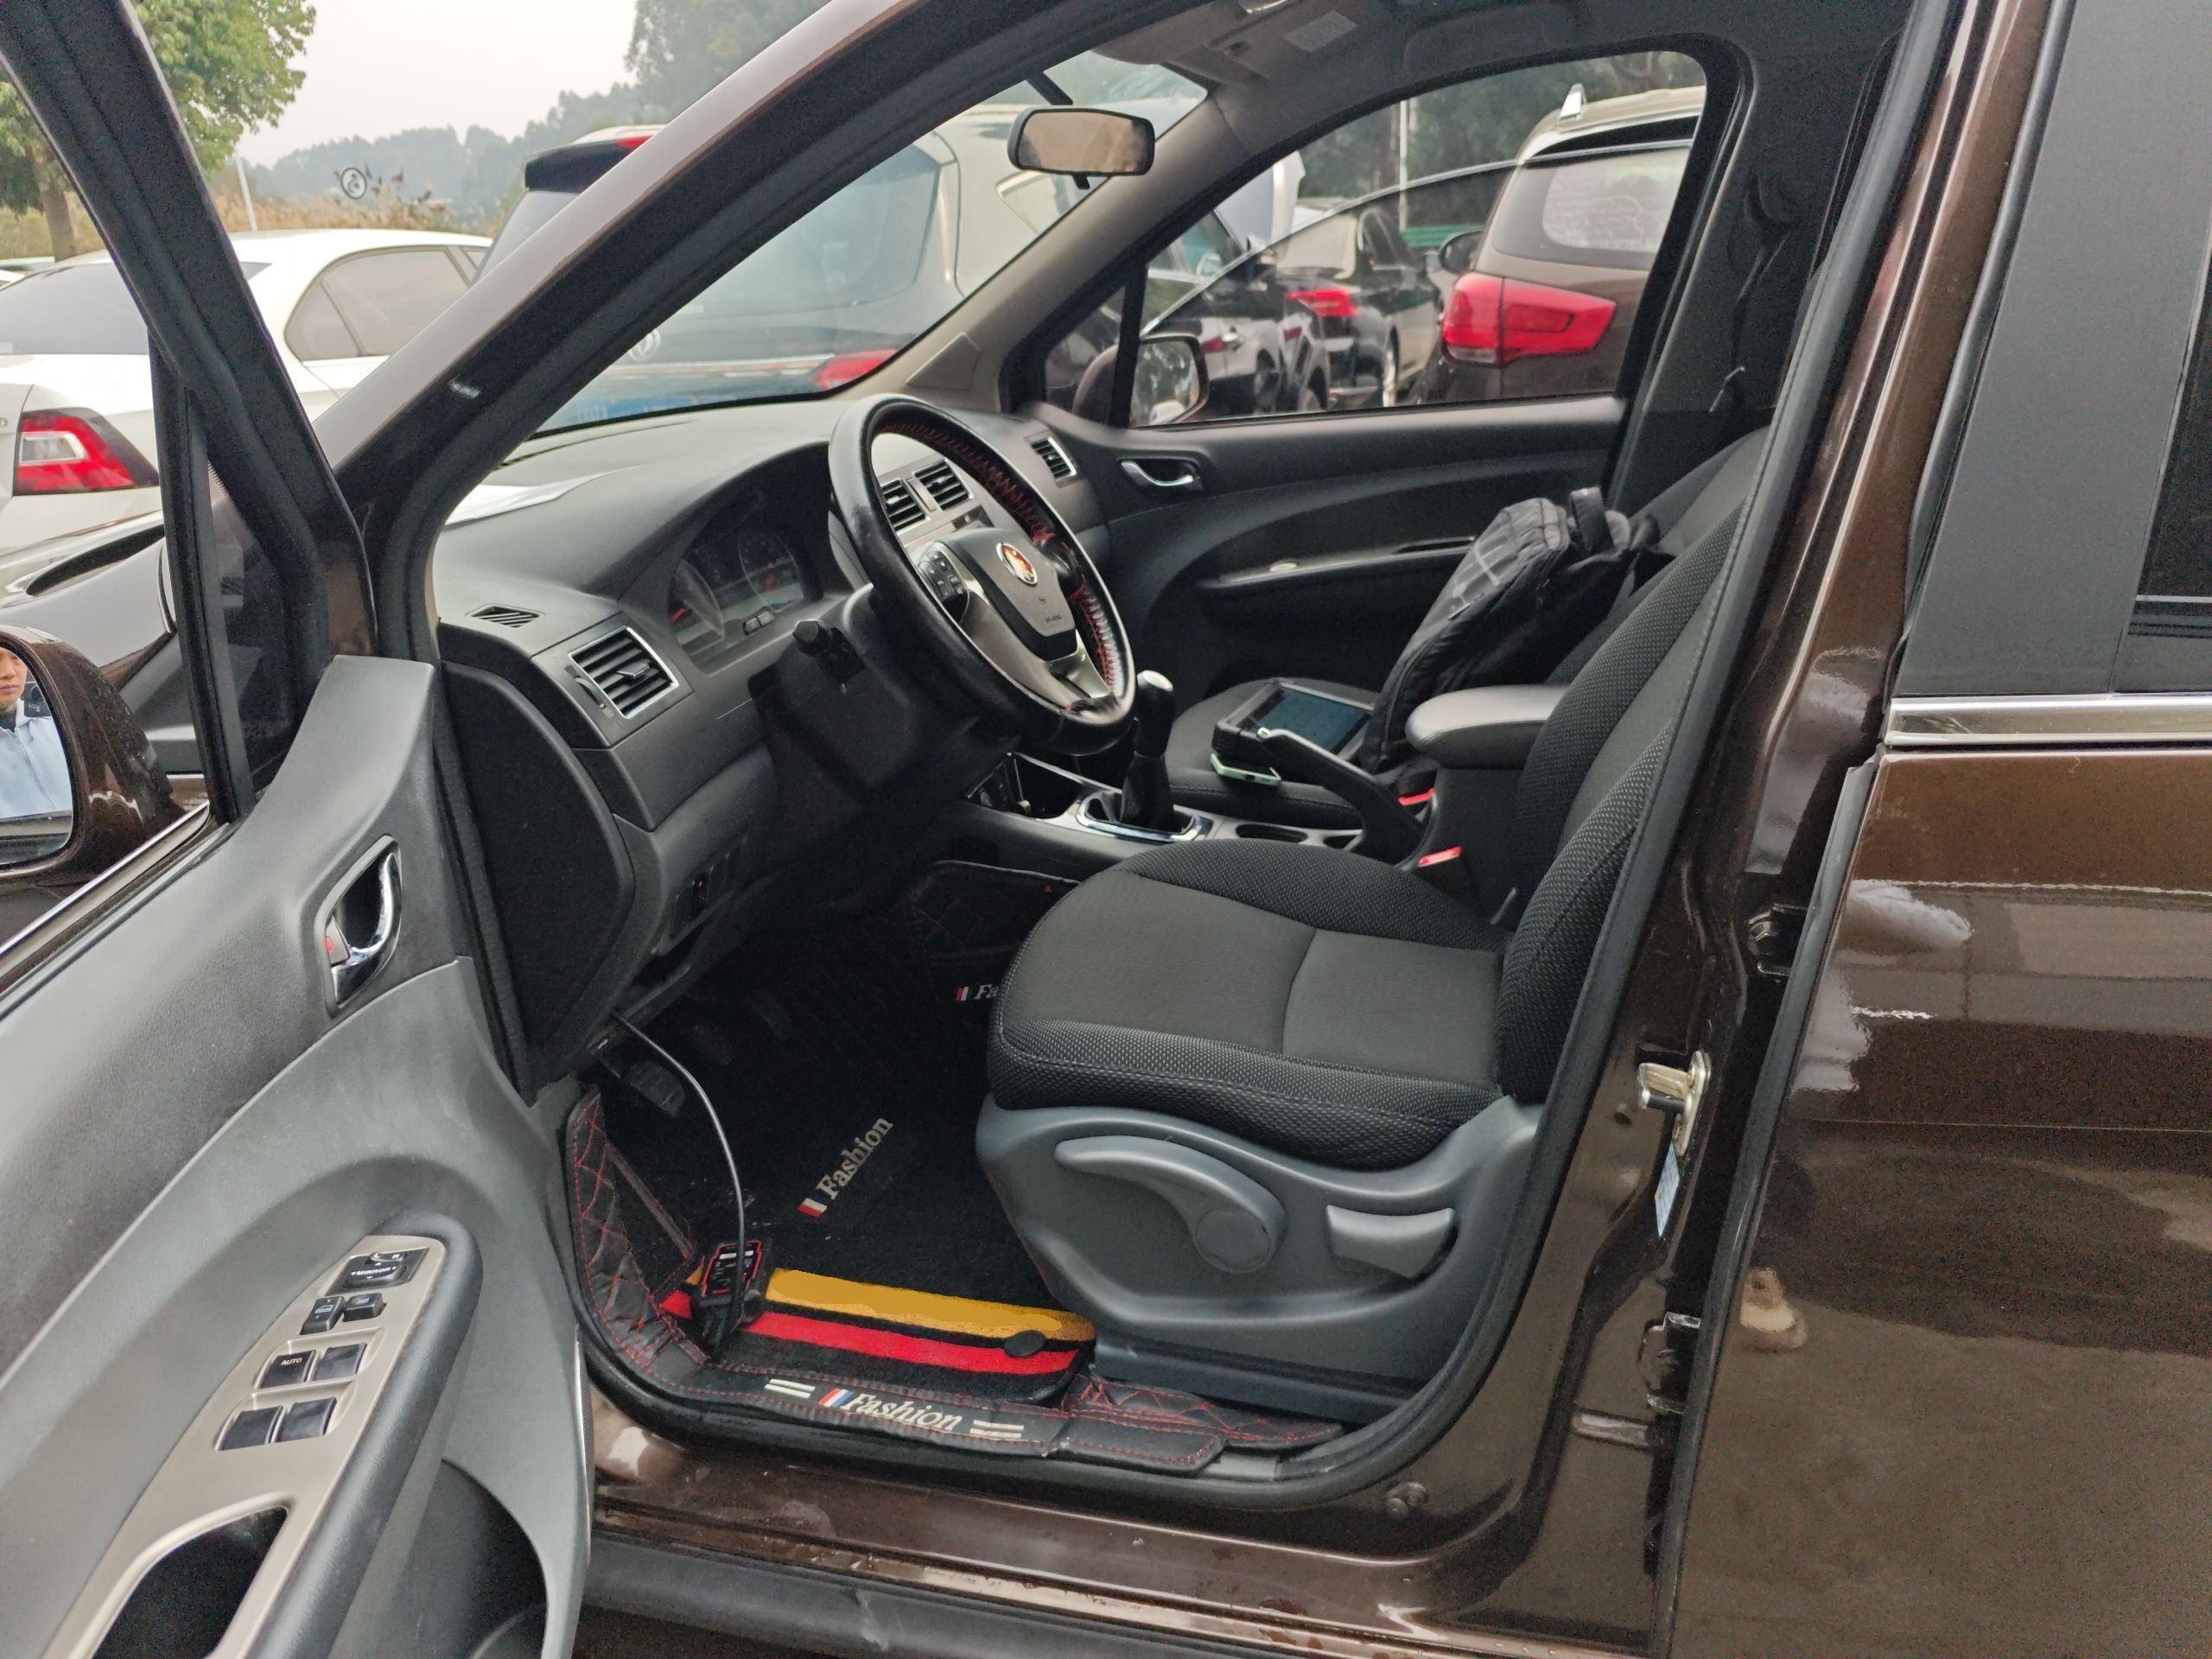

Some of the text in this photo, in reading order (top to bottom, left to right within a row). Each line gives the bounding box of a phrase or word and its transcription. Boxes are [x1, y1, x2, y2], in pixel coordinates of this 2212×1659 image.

[974, 984, 999, 1000] Fa
[816, 1118, 893, 1200] Fashion
[356, 1267, 391, 1275] MIRROR
[840, 1393, 963, 1431] Fashion
